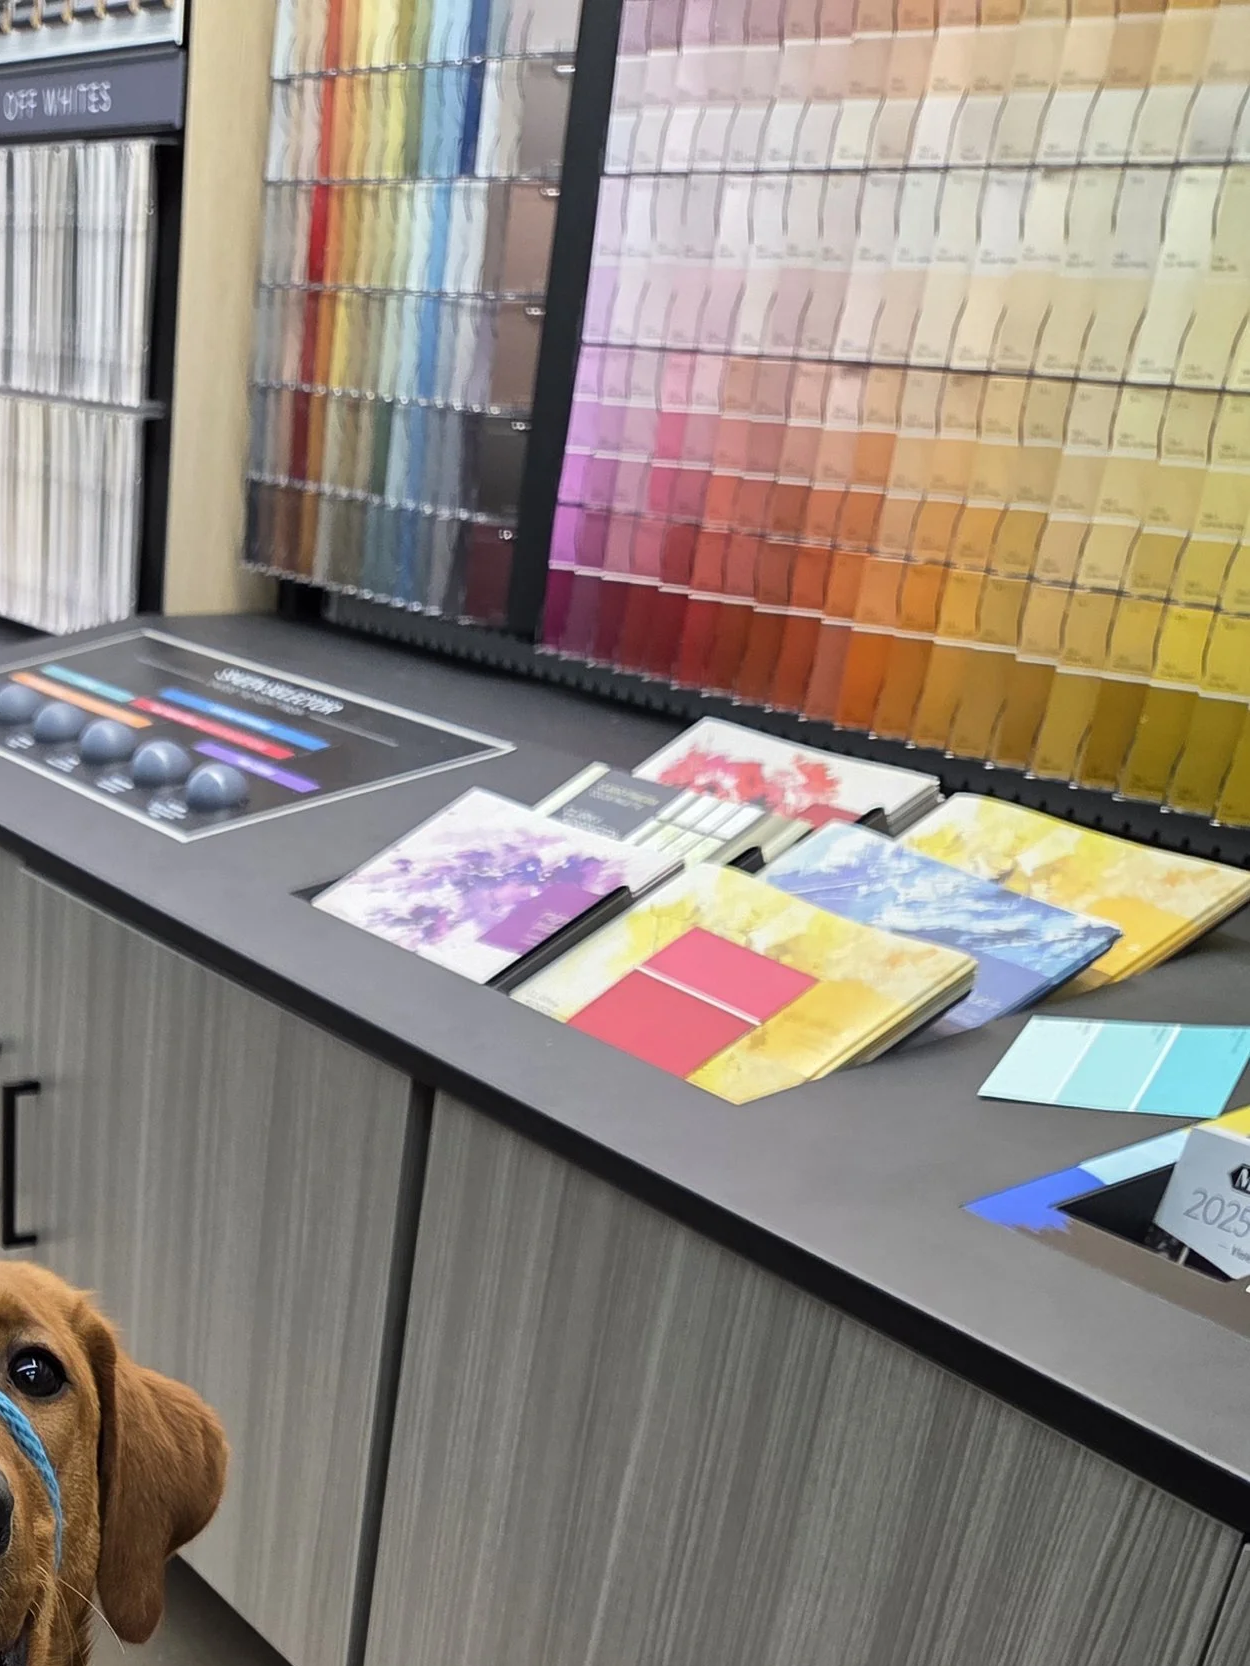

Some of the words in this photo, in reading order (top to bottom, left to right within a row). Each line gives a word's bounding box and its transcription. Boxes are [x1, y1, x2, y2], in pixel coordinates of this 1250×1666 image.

[3, 88, 37, 120] OFF
[42, 81, 111, 116] WHITES
[1183, 1189, 1250, 1238] 2025
